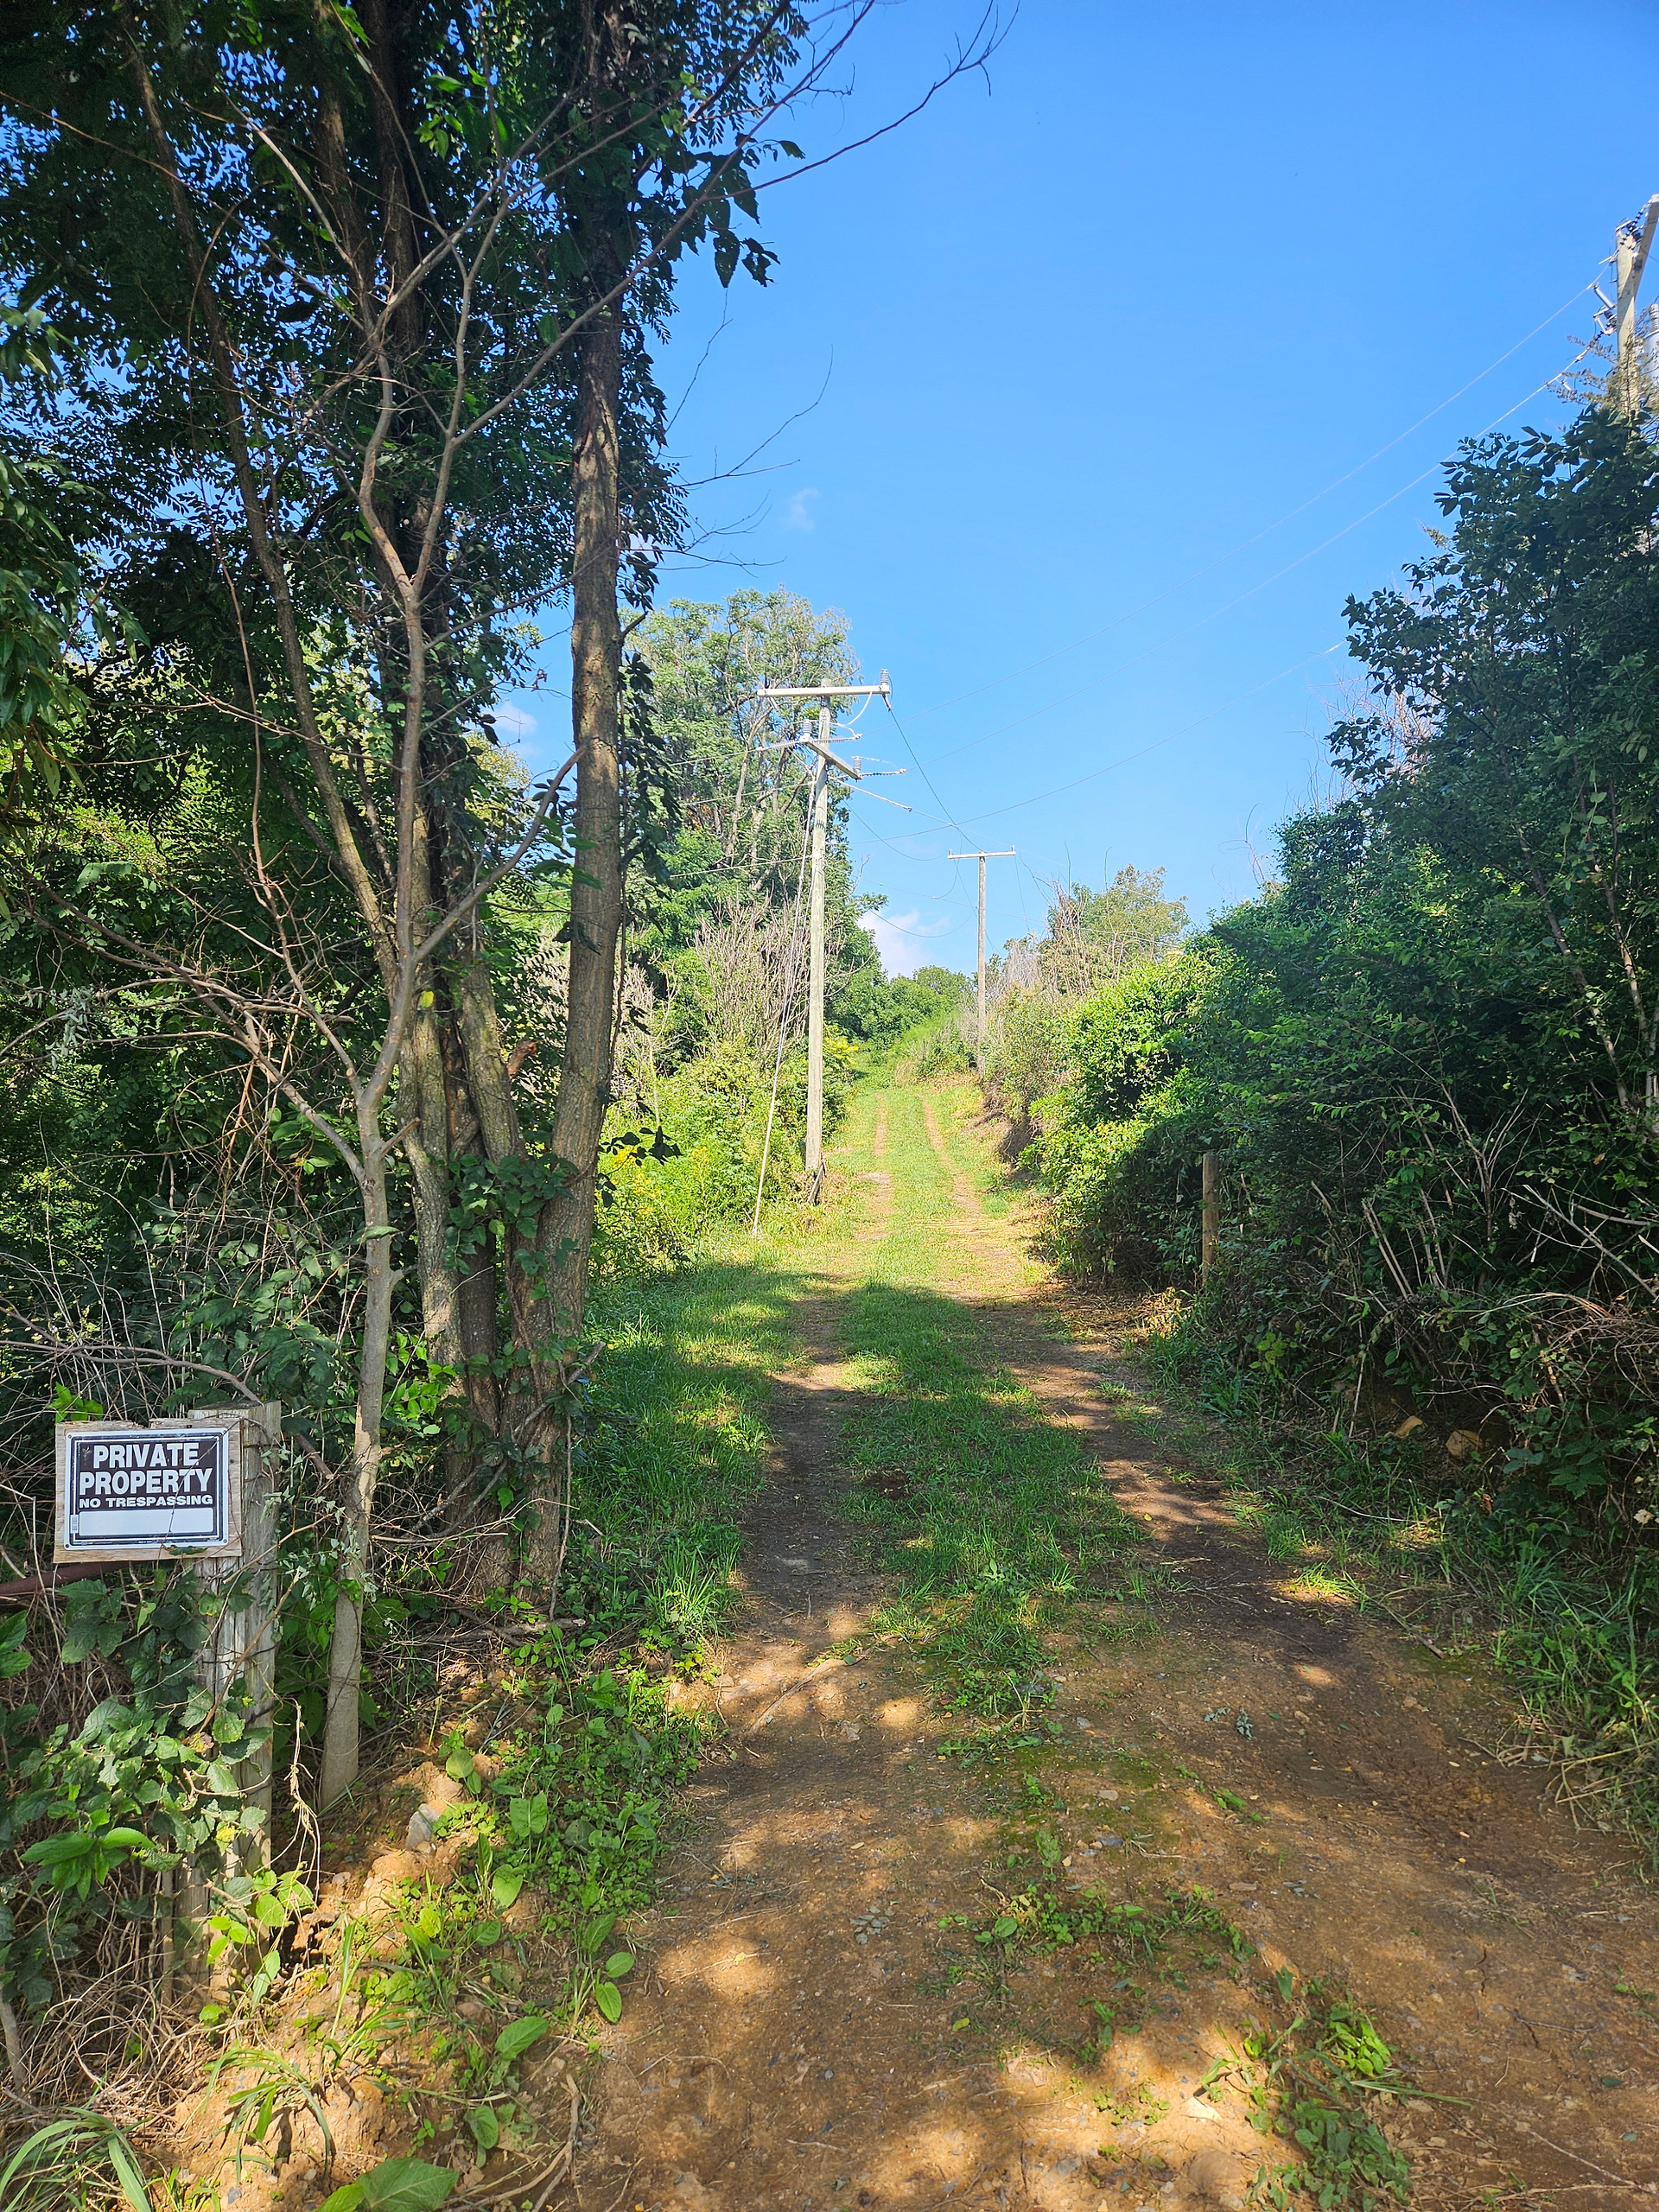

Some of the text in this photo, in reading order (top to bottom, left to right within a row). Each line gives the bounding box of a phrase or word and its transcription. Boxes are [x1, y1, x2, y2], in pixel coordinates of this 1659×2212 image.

[93, 1442, 199, 1468] PRIVATE
[79, 1468, 213, 1495] PROPERTY
[79, 1495, 213, 1509] NO TRESPASSING
